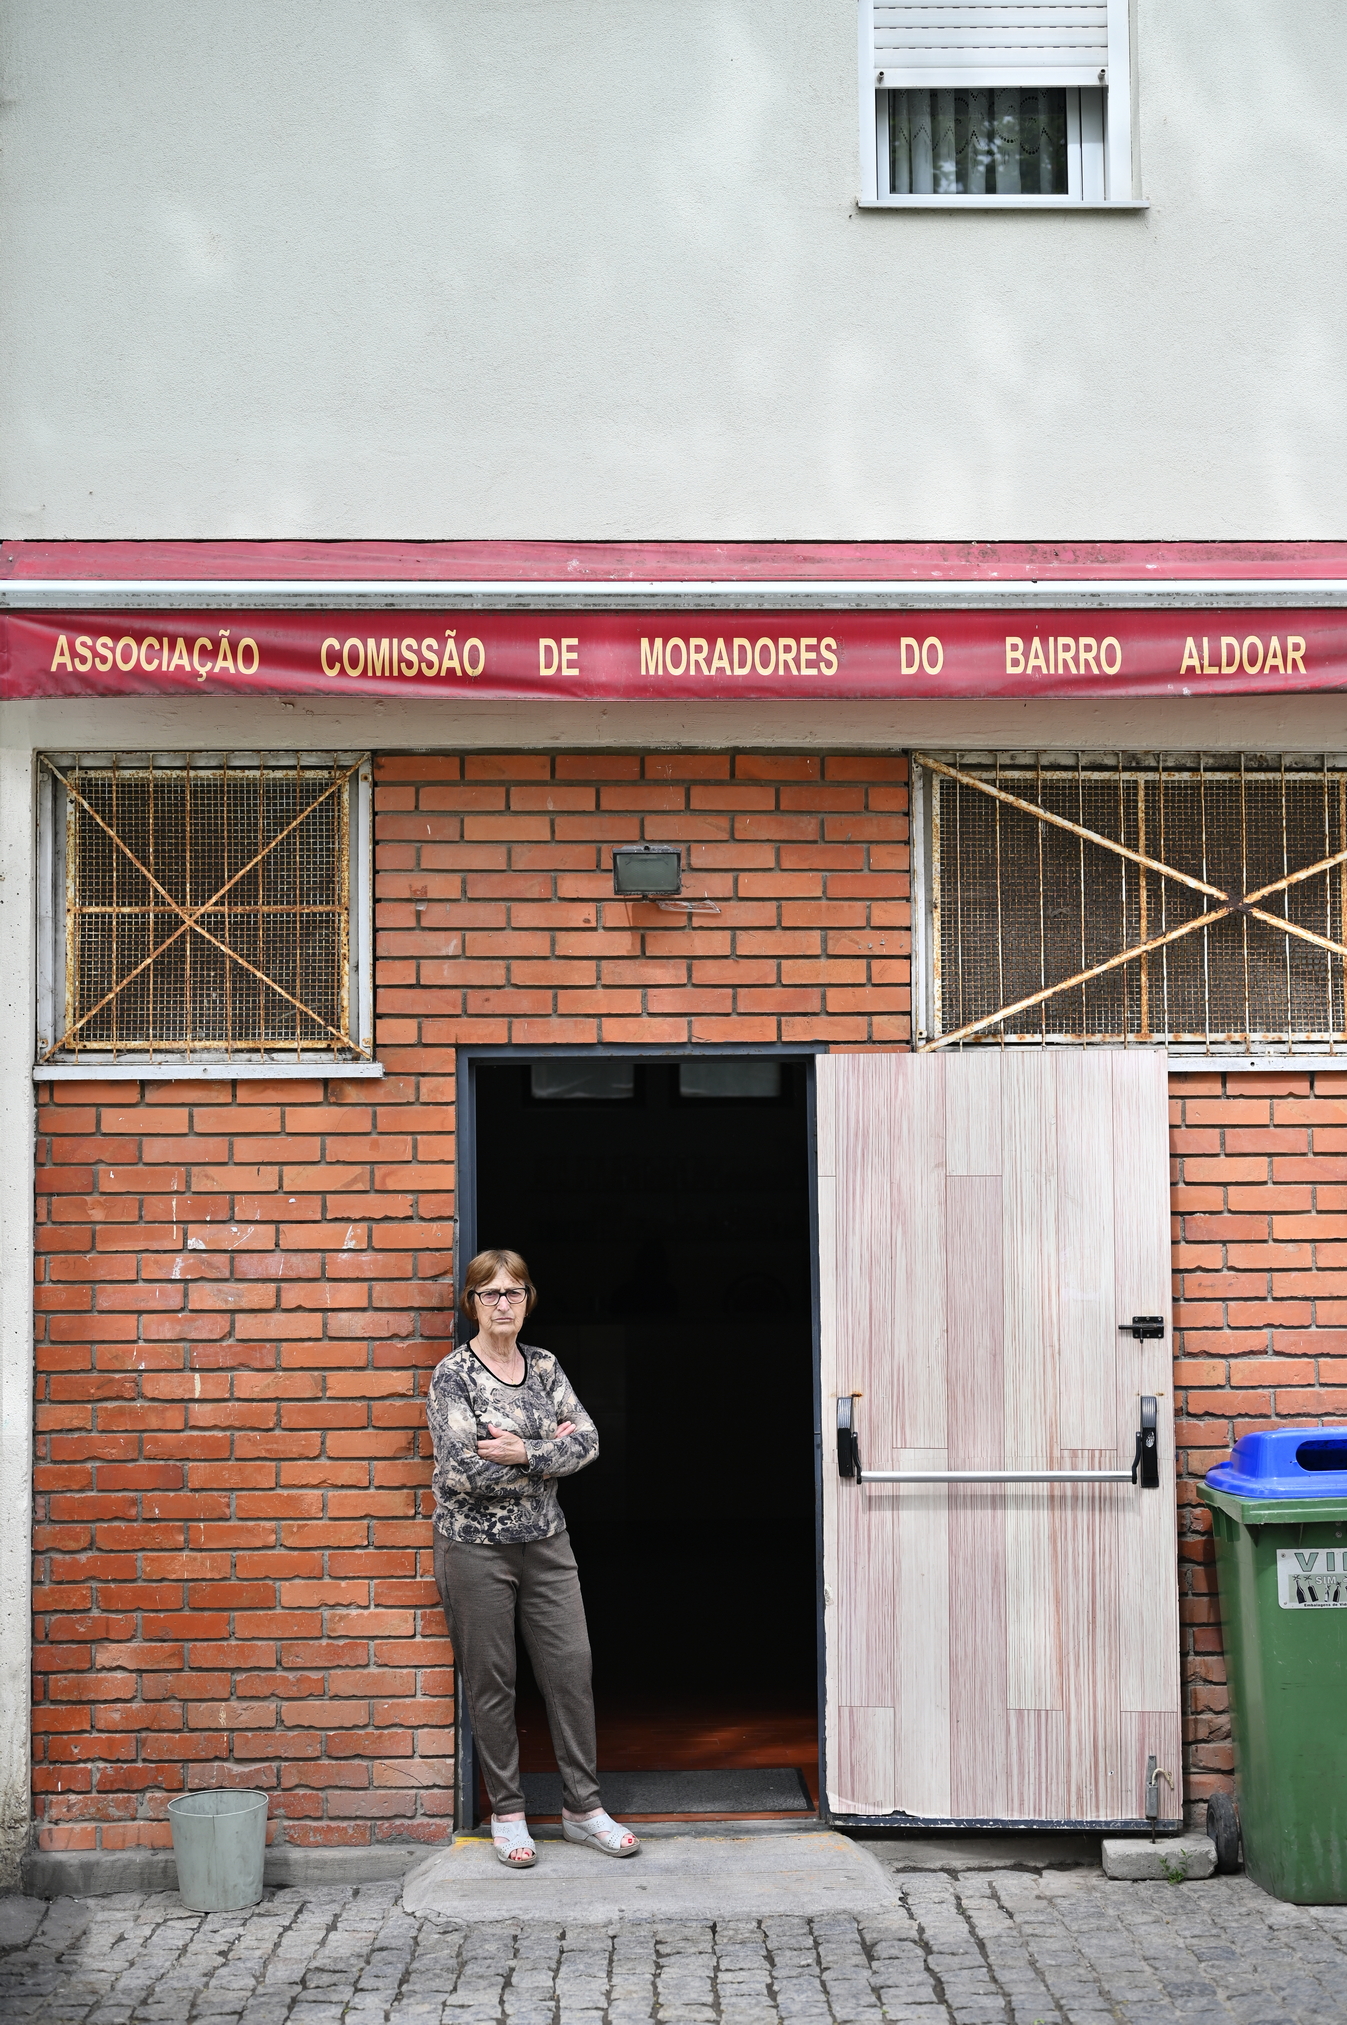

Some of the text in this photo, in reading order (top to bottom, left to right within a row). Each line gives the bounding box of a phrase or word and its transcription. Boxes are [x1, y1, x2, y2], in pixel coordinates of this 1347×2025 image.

[50, 629, 1308, 682] ASSOCIAÇÃO COMISSÃO DE MORADORES DO BAIRRO ALDOAR
[1315, 1576, 1337, 1585] SIM
